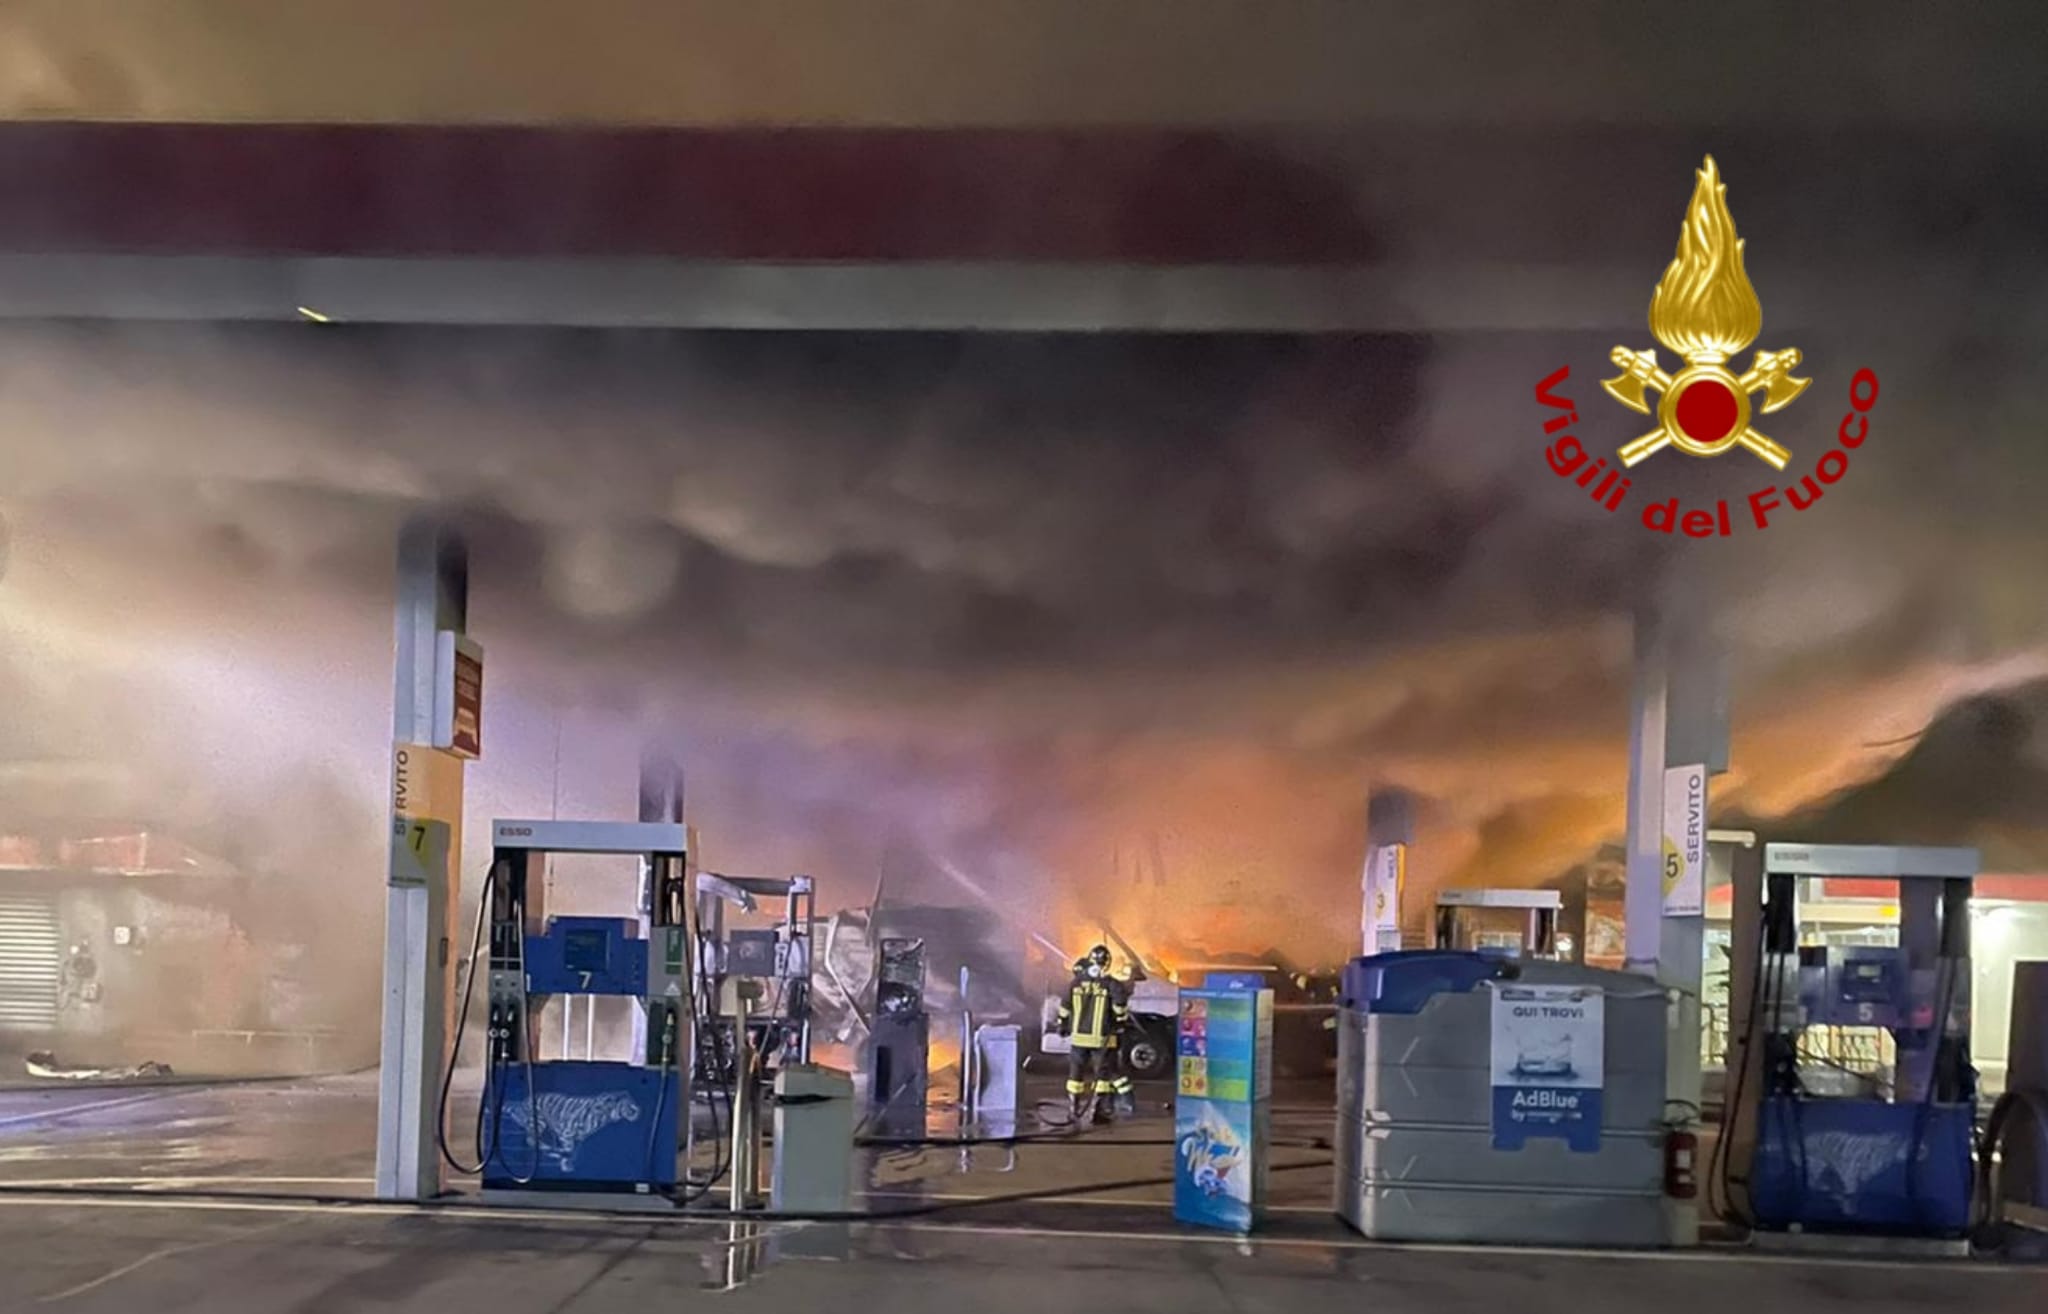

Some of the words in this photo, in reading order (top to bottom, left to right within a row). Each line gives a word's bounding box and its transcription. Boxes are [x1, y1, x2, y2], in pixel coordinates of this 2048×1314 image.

[1687, 774, 1701, 864] SERVITO
[413, 825, 425, 851] 7
[500, 827, 532, 837] ESSO
[1665, 853, 1679, 878] 5
[578, 971, 592, 989] 7
[1859, 1002, 1873, 1021] 5
[1511, 1090, 1579, 1108] AdBlue
